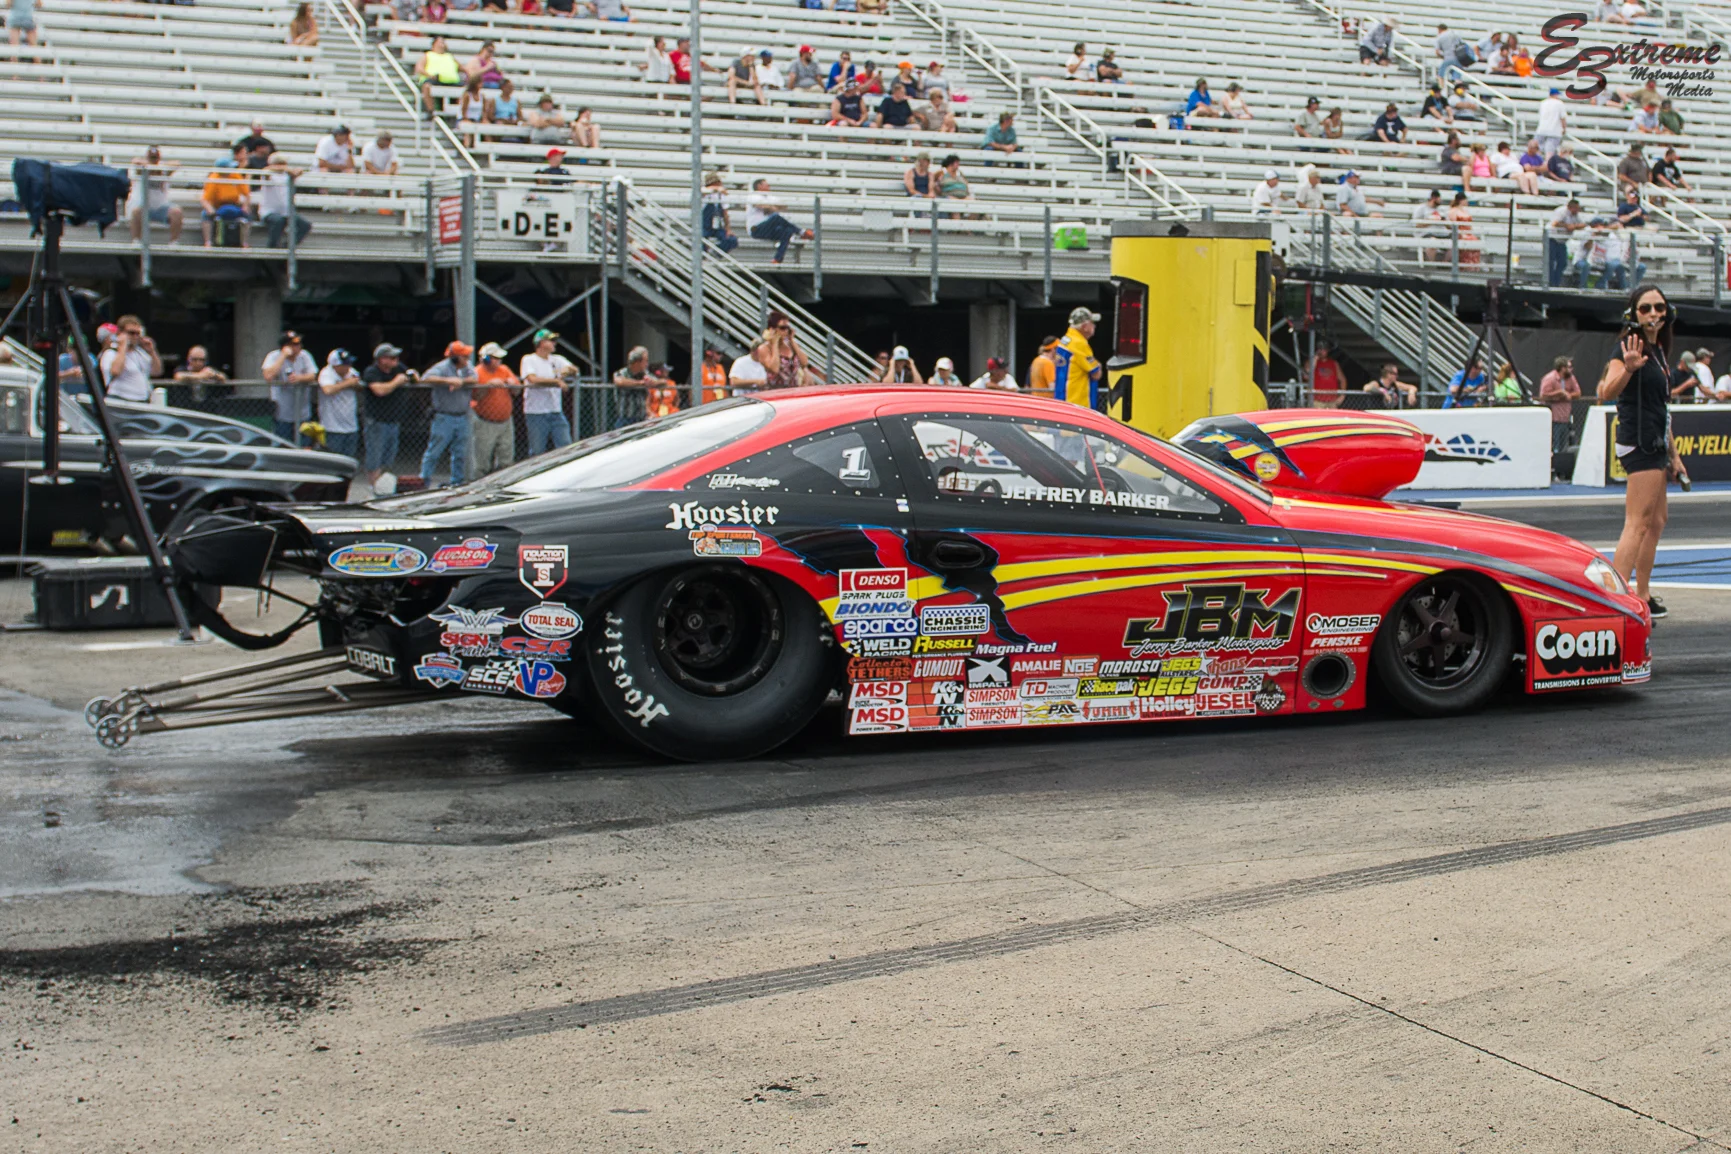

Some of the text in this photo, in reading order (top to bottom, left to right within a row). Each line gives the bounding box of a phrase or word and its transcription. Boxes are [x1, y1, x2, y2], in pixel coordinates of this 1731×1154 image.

[839, 446, 871, 480] 1
[1001, 485, 1170, 510] JEFFREY BARKER
[665, 499, 780, 530] Hoosier
[439, 550, 489, 560] LUCAS OIL
[859, 574, 900, 586] DENSO
[842, 591, 905, 600] SPARK PLUGS
[836, 601, 911, 615] BIONDO
[1122, 583, 1302, 647] JBM
[528, 614, 575, 627] TOTAL SEAL
[844, 618, 918, 638] sparco
[924, 616, 986, 627] CHASSIS
[924, 624, 986, 632] ENGINEERING
[1322, 617, 1380, 627] MOSER
[442, 633, 488, 646] SIGN
[501, 636, 571, 654] CSR
[863, 638, 911, 651] WELD
[913, 636, 975, 653] RUSSELL
[1131, 636, 1285, 658] Jerry Barker Motorsports
[1310, 636, 1363, 648] PENSKE
[1535, 624, 1617, 661] Coan
[975, 641, 1057, 656] Magna Fuel
[347, 646, 396, 675] COBALT
[1012, 660, 1062, 672] AMALIE
[1064, 658, 1097, 673] NOS
[1098, 660, 1161, 674] MOROSO
[1161, 657, 1202, 671] JEGS
[1208, 656, 1247, 677] hans
[468, 667, 510, 685] SCE
[597, 610, 670, 728] Hoosier
[850, 667, 911, 678] TETHERS
[913, 659, 964, 678] GUMOUT
[520, 661, 554, 696] VP
[1199, 676, 1248, 690] COMP
[1534, 679, 1580, 690] TRANSMISSIONS
[1587, 676, 1621, 686] CONVERTERS
[855, 681, 905, 698] MSD
[1137, 676, 1199, 697] JEGS
[968, 689, 1018, 703] SIMPSON
[1196, 693, 1255, 711] JESEL
[1048, 703, 1081, 715] PAC
[1082, 700, 1138, 719] SUMMIT
[1142, 696, 1195, 715] Holley
[856, 707, 905, 723] MSD
[969, 707, 1018, 721] SIMPSON
